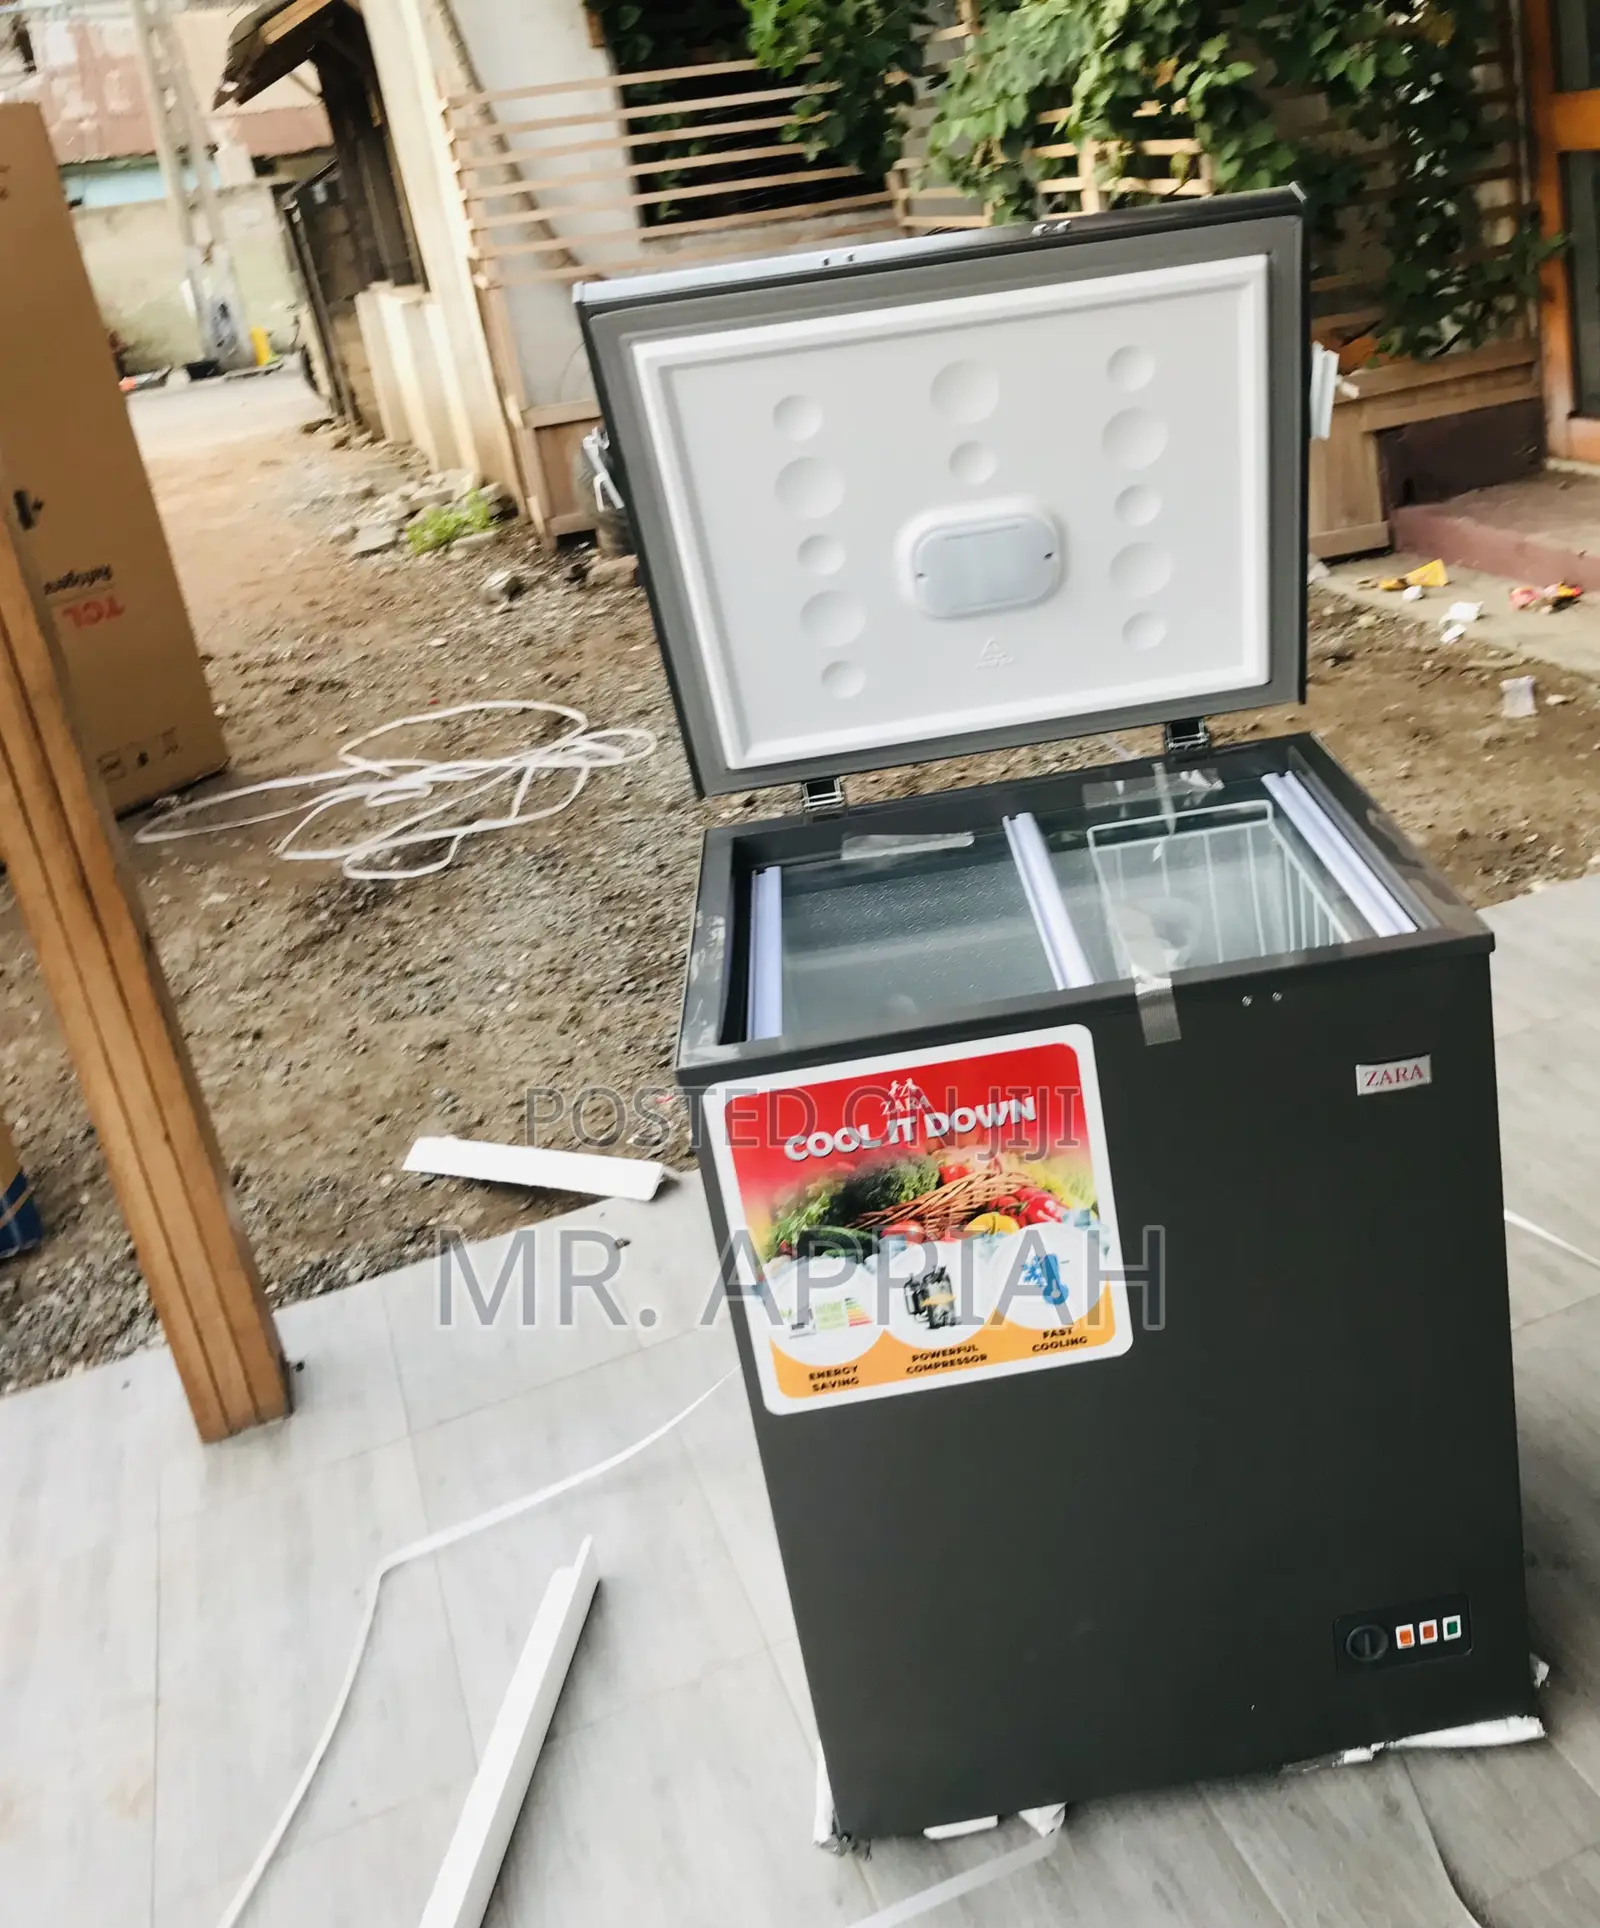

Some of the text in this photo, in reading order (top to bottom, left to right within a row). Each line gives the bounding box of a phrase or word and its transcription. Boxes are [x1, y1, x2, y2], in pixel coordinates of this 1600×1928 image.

[61, 595, 125, 628] TCL
[1364, 1063, 1424, 1087] ZARA
[880, 1094, 932, 1117] ZARA
[784, 1095, 1037, 1161] COOL IT DOWN
[1031, 1335, 1089, 1353] COOLING
[1042, 1326, 1074, 1340] FAST
[905, 1353, 989, 1376] COMPRESSOR
[911, 1343, 979, 1364] POWERFUL
[808, 1365, 859, 1382] ENERGY
[811, 1376, 860, 1393] SAVING
